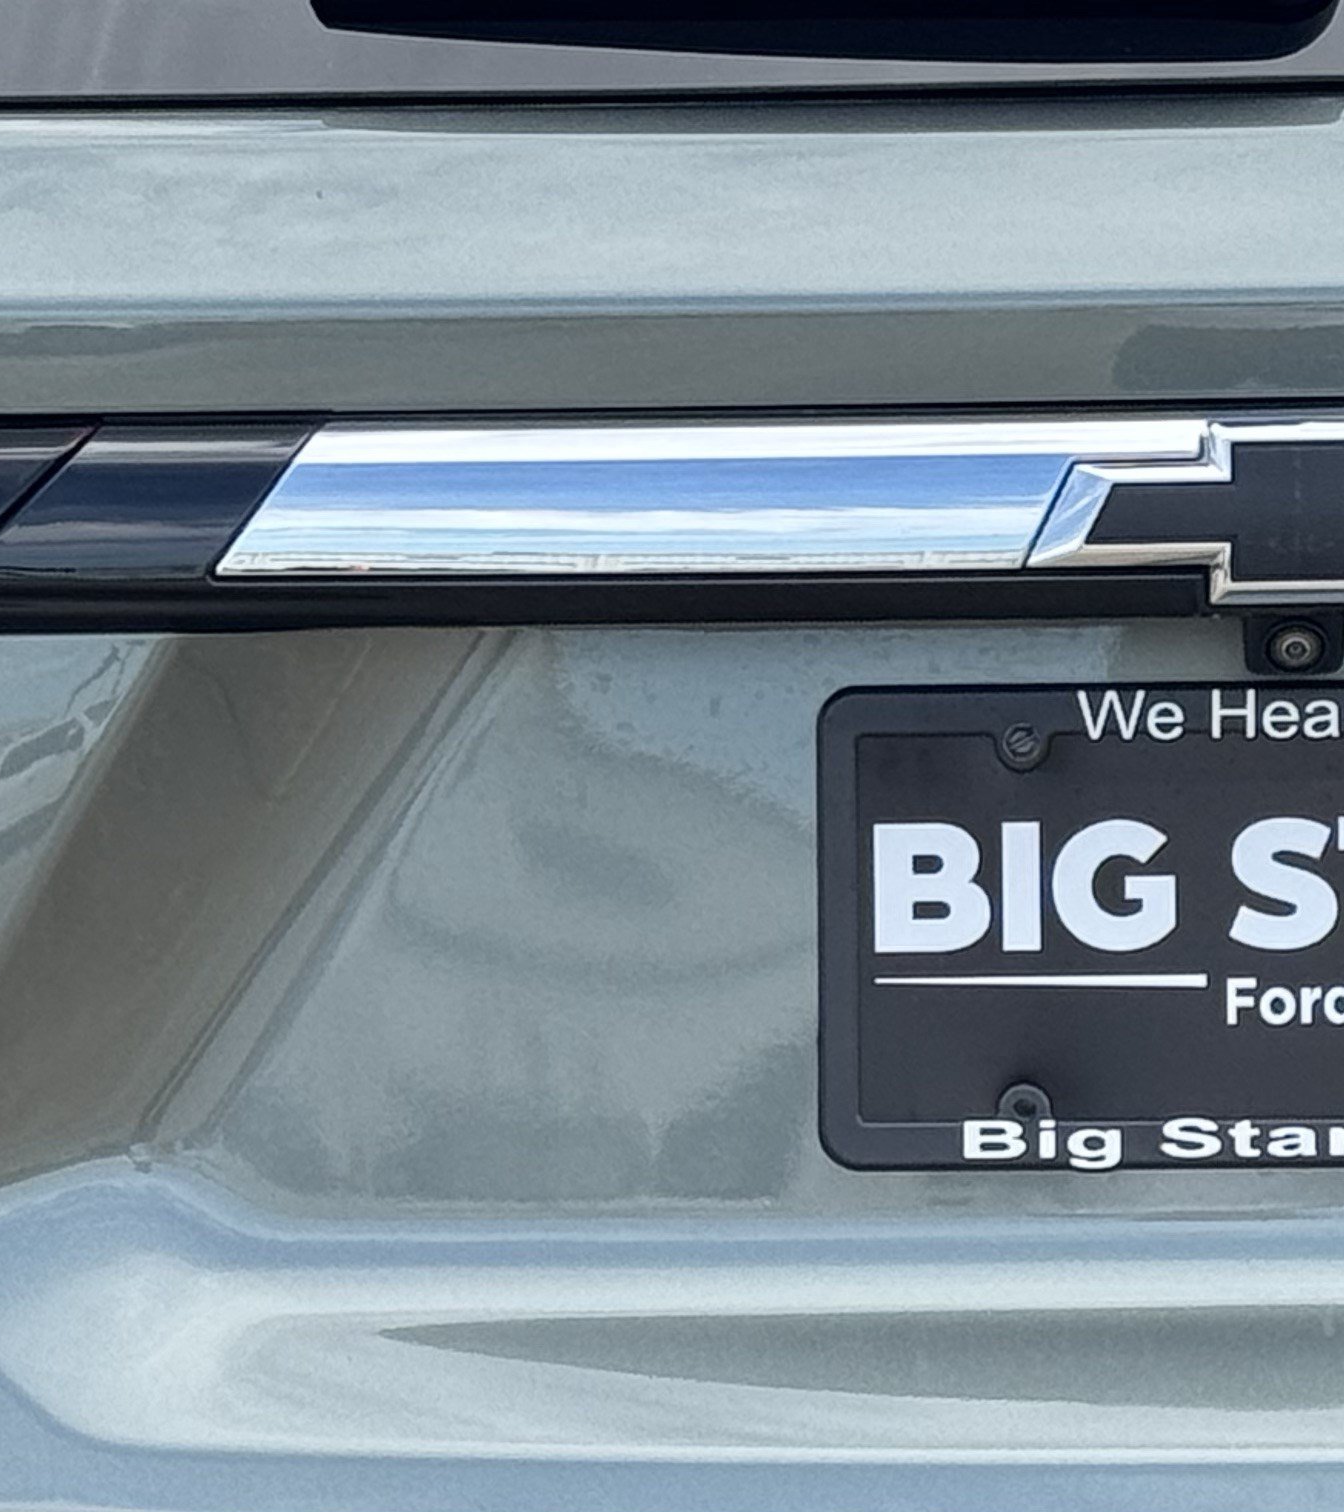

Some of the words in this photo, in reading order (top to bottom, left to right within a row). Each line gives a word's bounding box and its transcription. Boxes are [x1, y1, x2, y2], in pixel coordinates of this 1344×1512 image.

[1077, 689, 1185, 741] We
[872, 818, 1179, 954] BIG
[961, 1118, 1124, 1170] Big
